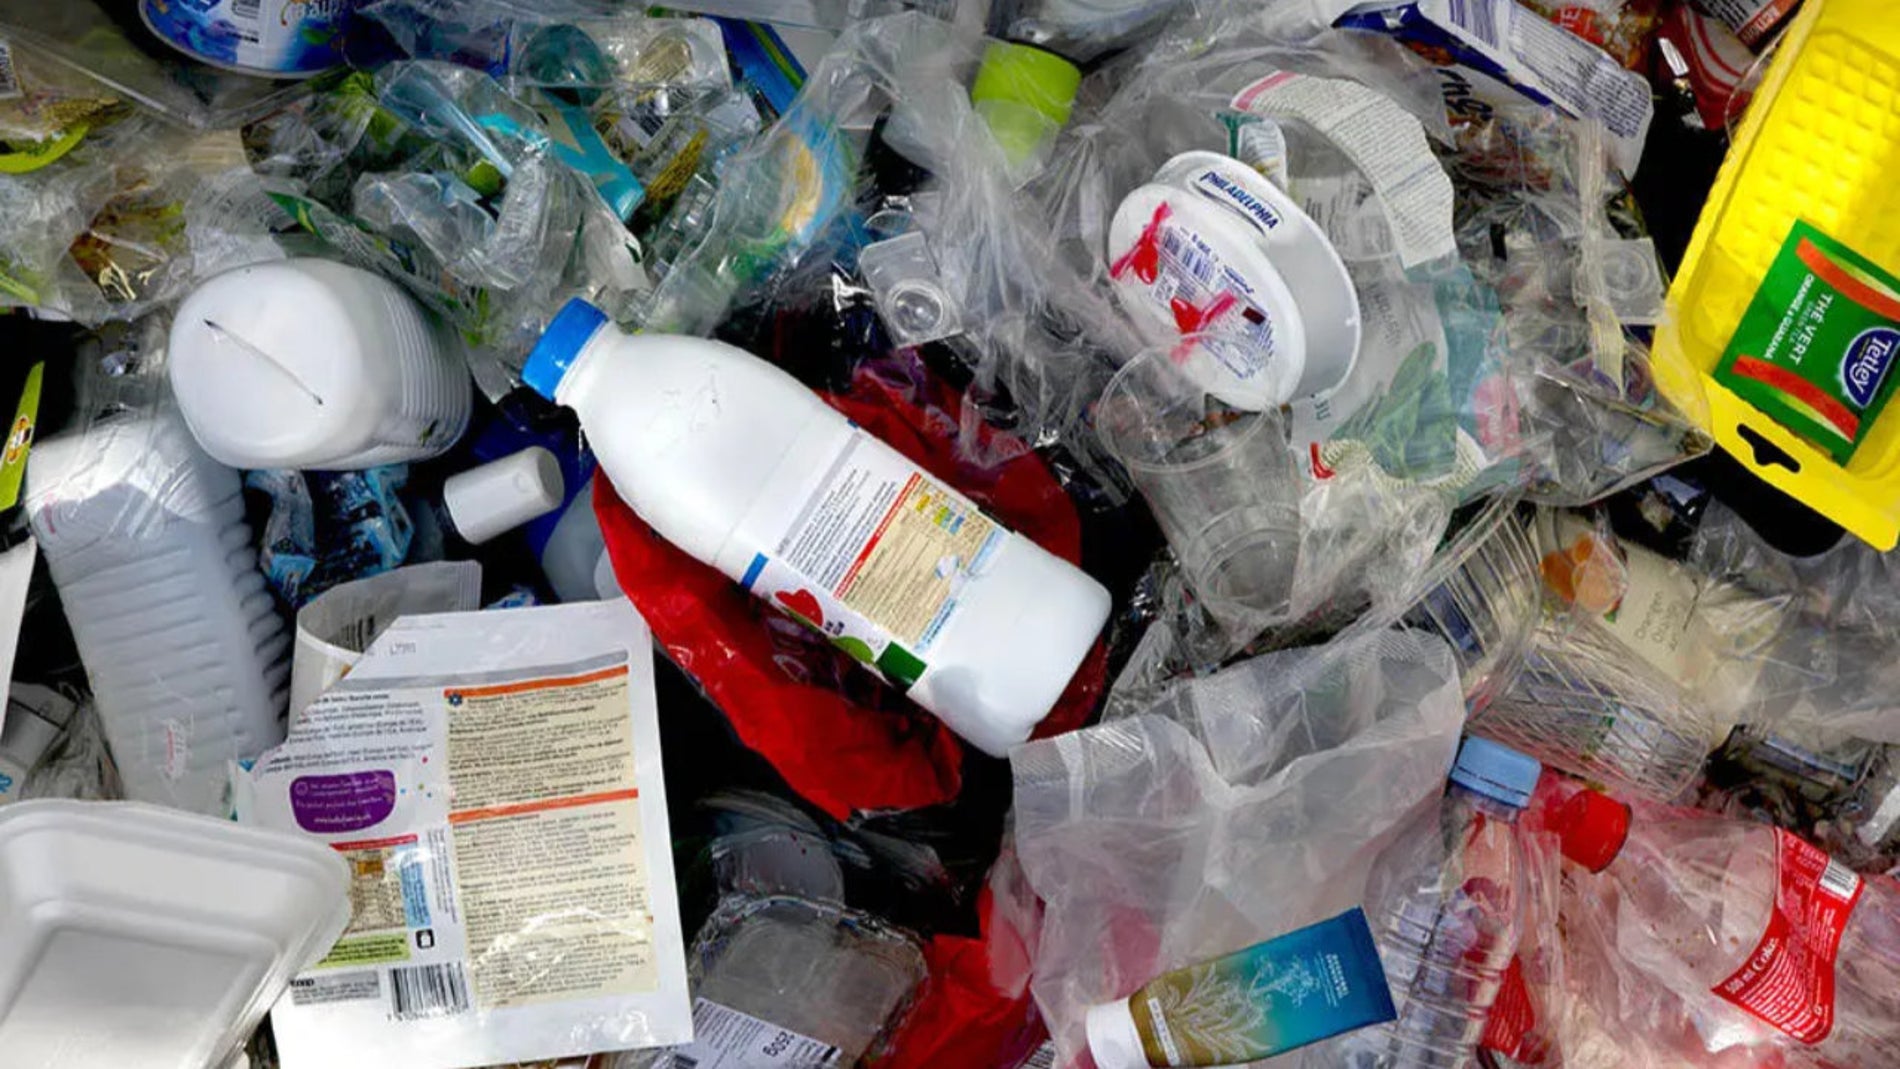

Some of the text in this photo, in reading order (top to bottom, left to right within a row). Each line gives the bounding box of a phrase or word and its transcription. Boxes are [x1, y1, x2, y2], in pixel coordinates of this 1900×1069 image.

[1199, 171, 1278, 229] PHILADELPHIA
[1792, 273, 1815, 311] ORANGE
[1788, 292, 1834, 366] THÉ VERT
[1850, 337, 1893, 395] Tetley
